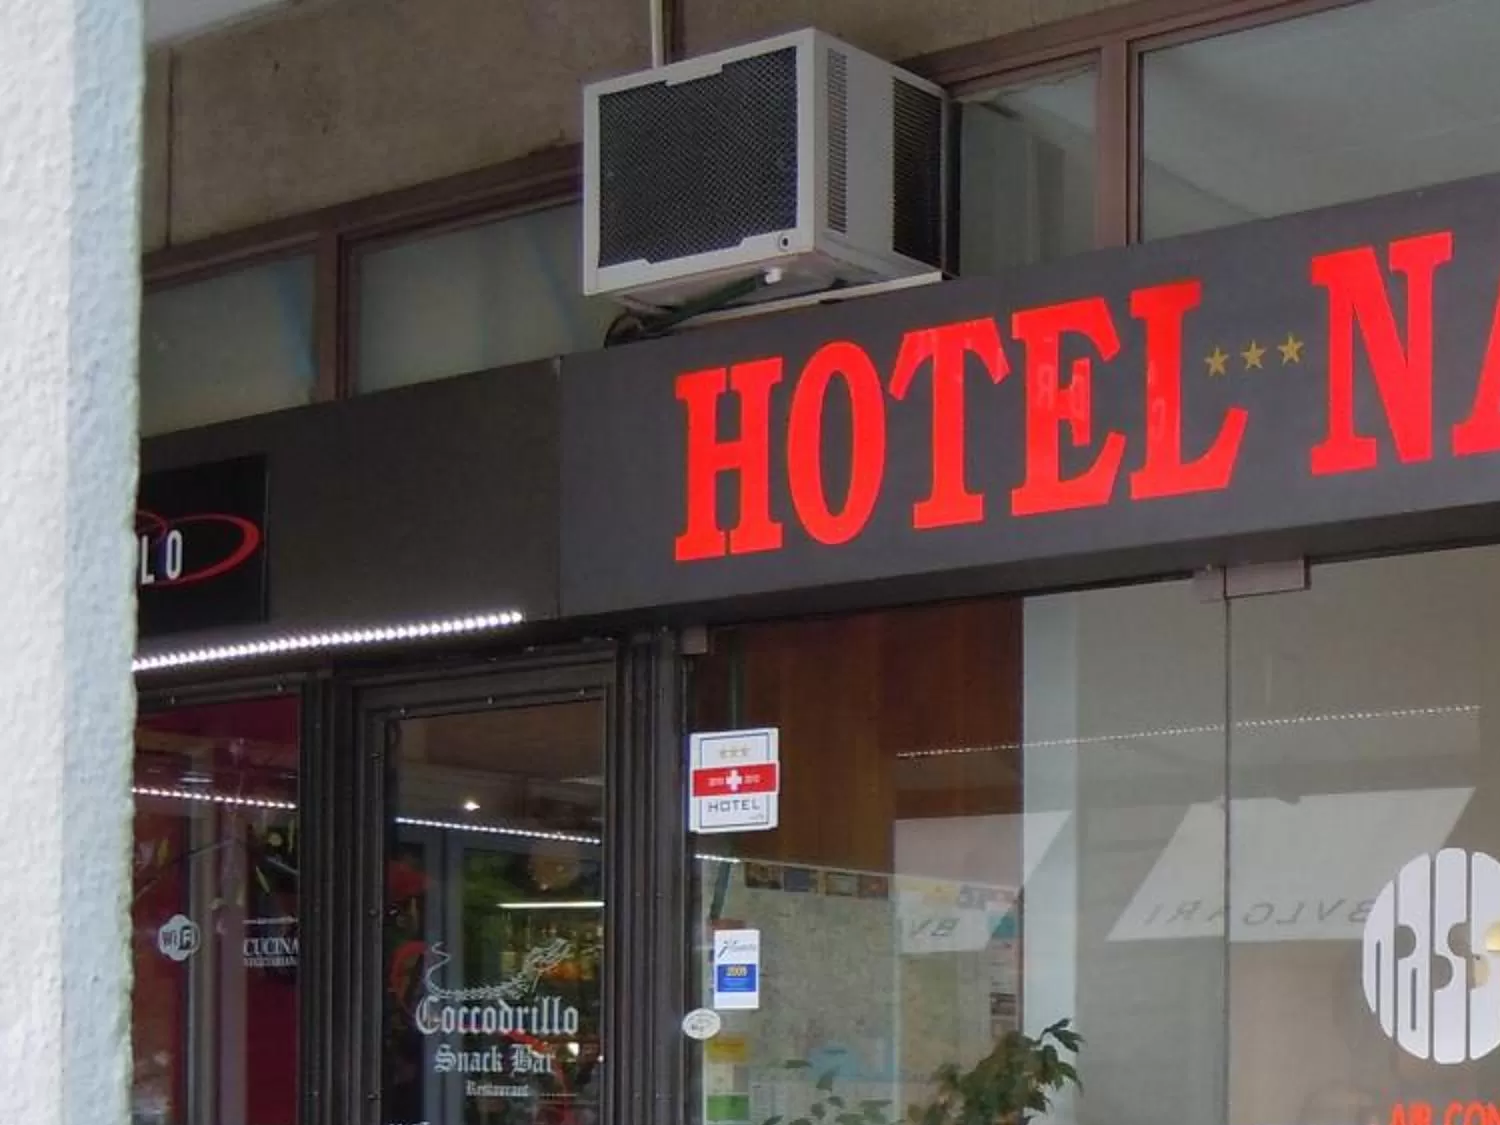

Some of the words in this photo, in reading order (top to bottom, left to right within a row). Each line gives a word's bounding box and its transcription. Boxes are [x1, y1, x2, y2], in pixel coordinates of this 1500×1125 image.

[675, 281, 1249, 562] HOTEL
[707, 799, 761, 812] HOTEL
[415, 995, 578, 1034] Coccodrillo
[434, 1044, 503, 1073] Snack
[511, 1044, 556, 1074] Bar
